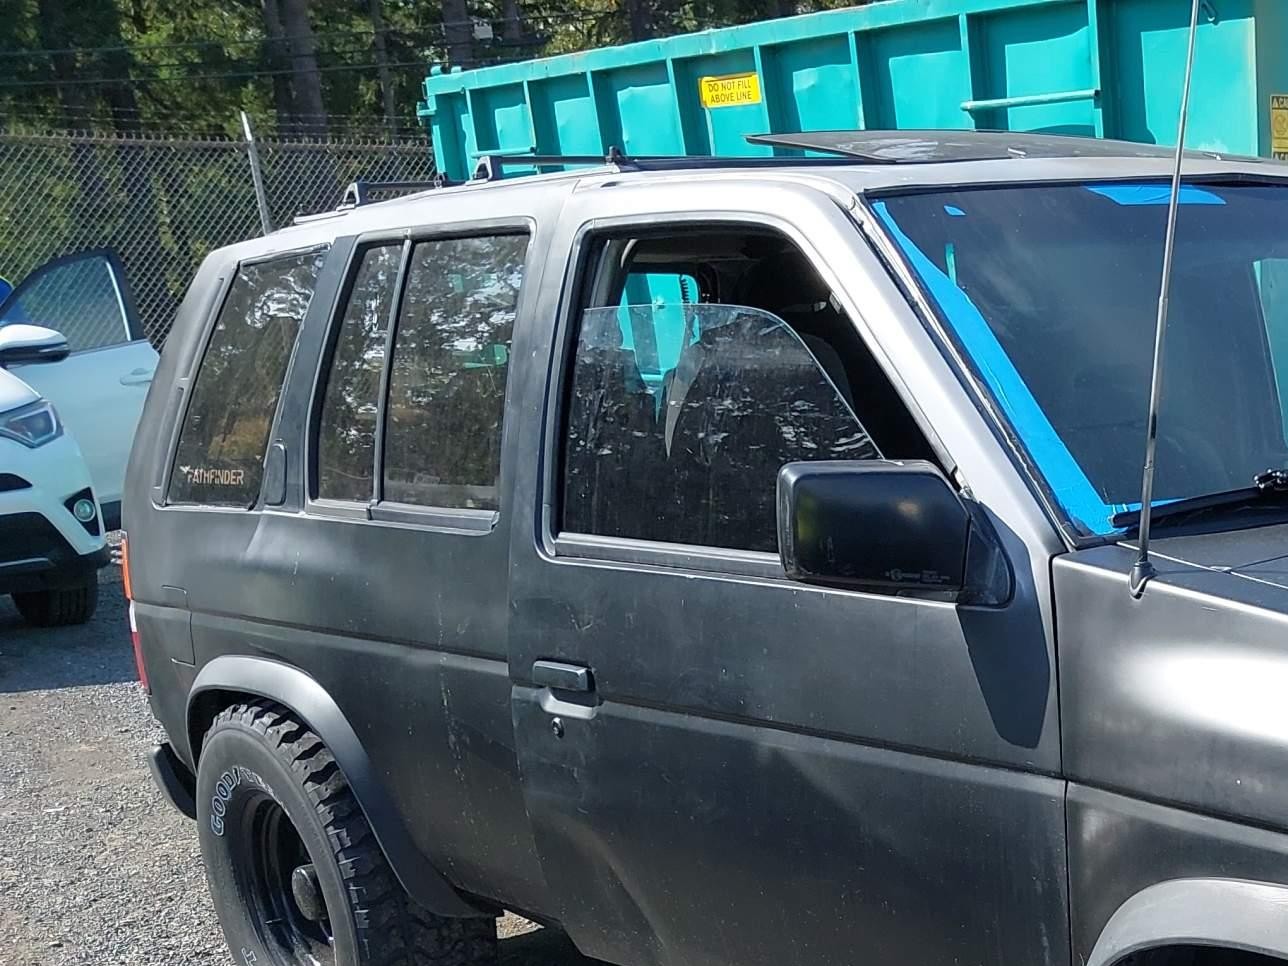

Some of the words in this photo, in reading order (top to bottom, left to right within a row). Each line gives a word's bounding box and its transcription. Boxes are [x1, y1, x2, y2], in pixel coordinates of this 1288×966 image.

[708, 83, 719, 92] DO
[721, 81, 735, 91] NOT
[737, 80, 751, 89] FILL
[711, 92, 735, 103] ABOVE
[736, 91, 752, 101] LINE
[187, 468, 244, 485] PATHFINDER
